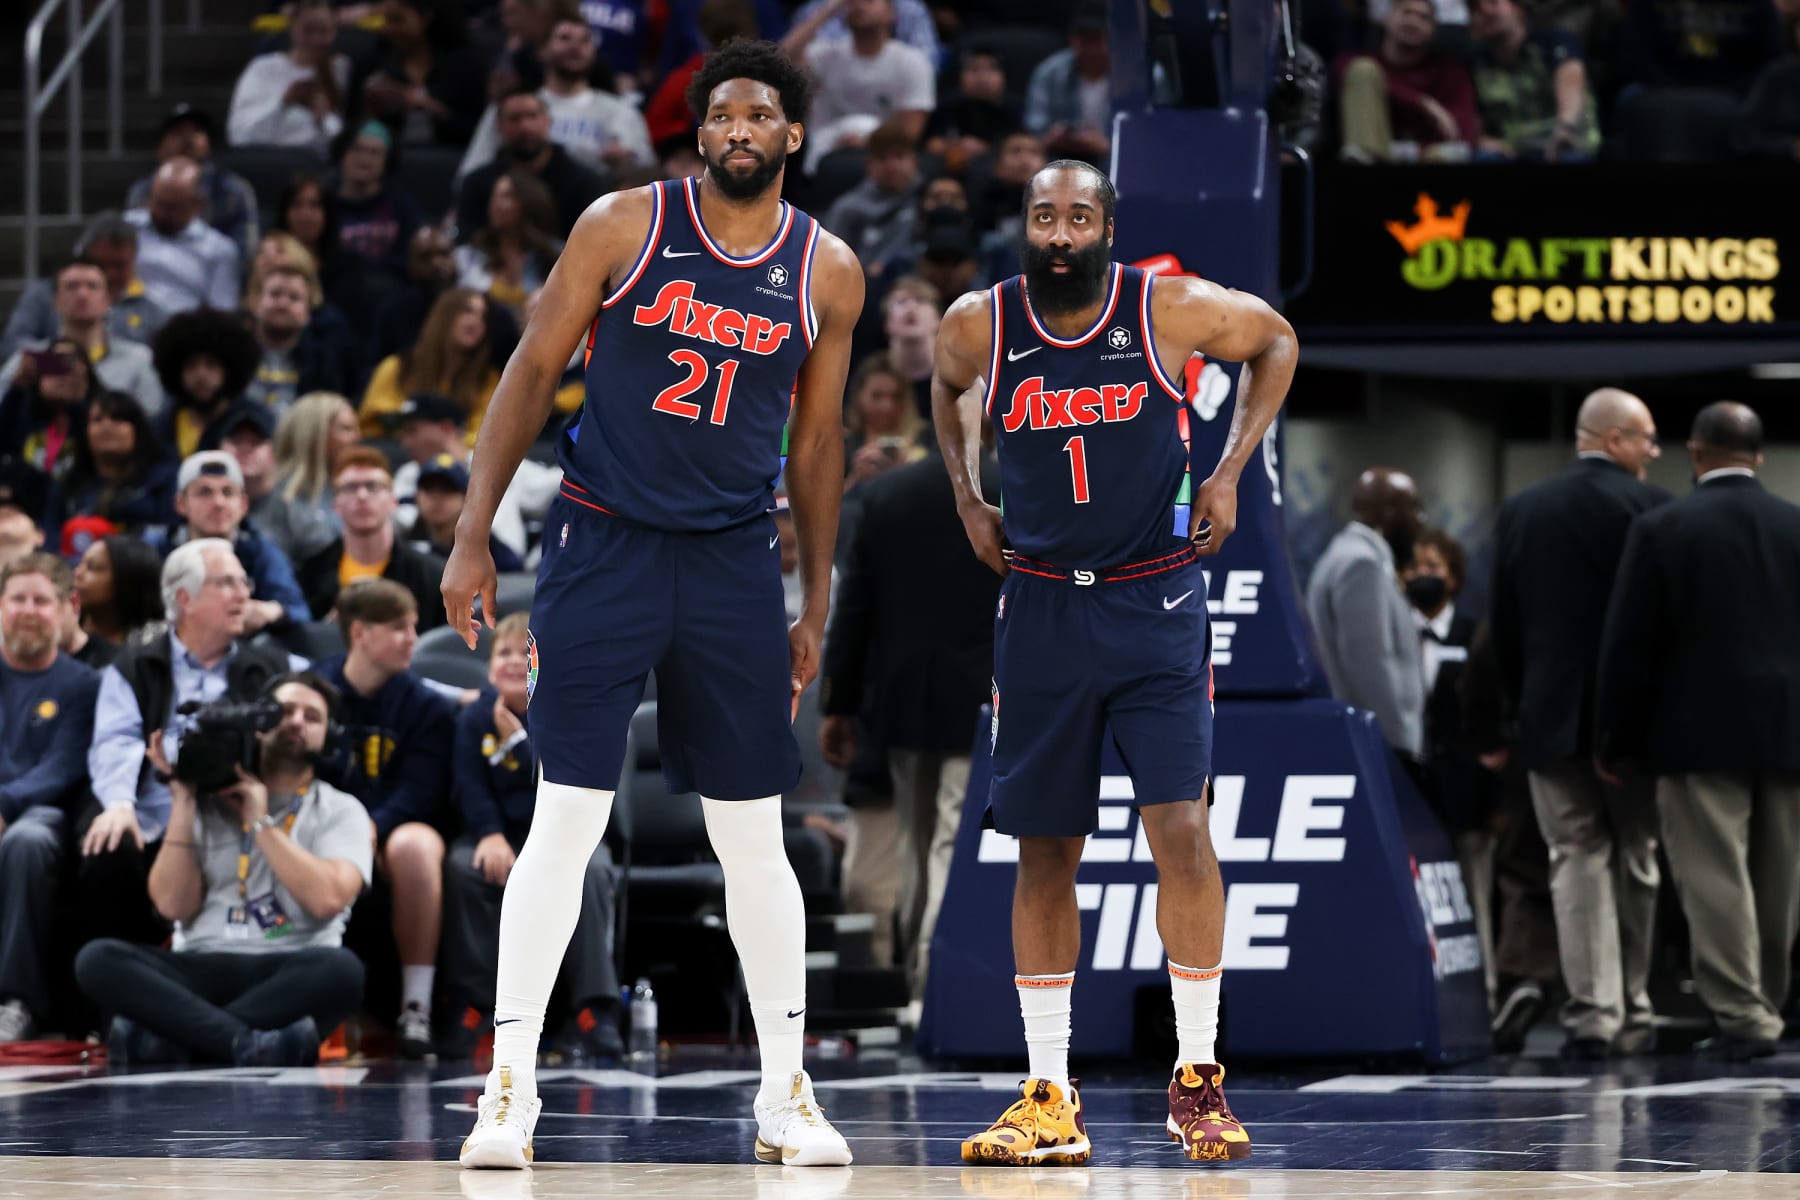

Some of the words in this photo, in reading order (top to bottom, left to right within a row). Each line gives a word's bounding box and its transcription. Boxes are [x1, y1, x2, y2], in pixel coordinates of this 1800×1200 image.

[1403, 238, 1780, 290] DRAFTKINGS
[755, 286, 794, 301] crypto.com
[1491, 285, 1776, 323] SPORTSBOOK
[1100, 351, 1142, 361] crypto.com
[652, 349, 739, 426] 21
[1063, 436, 1090, 504] 1
